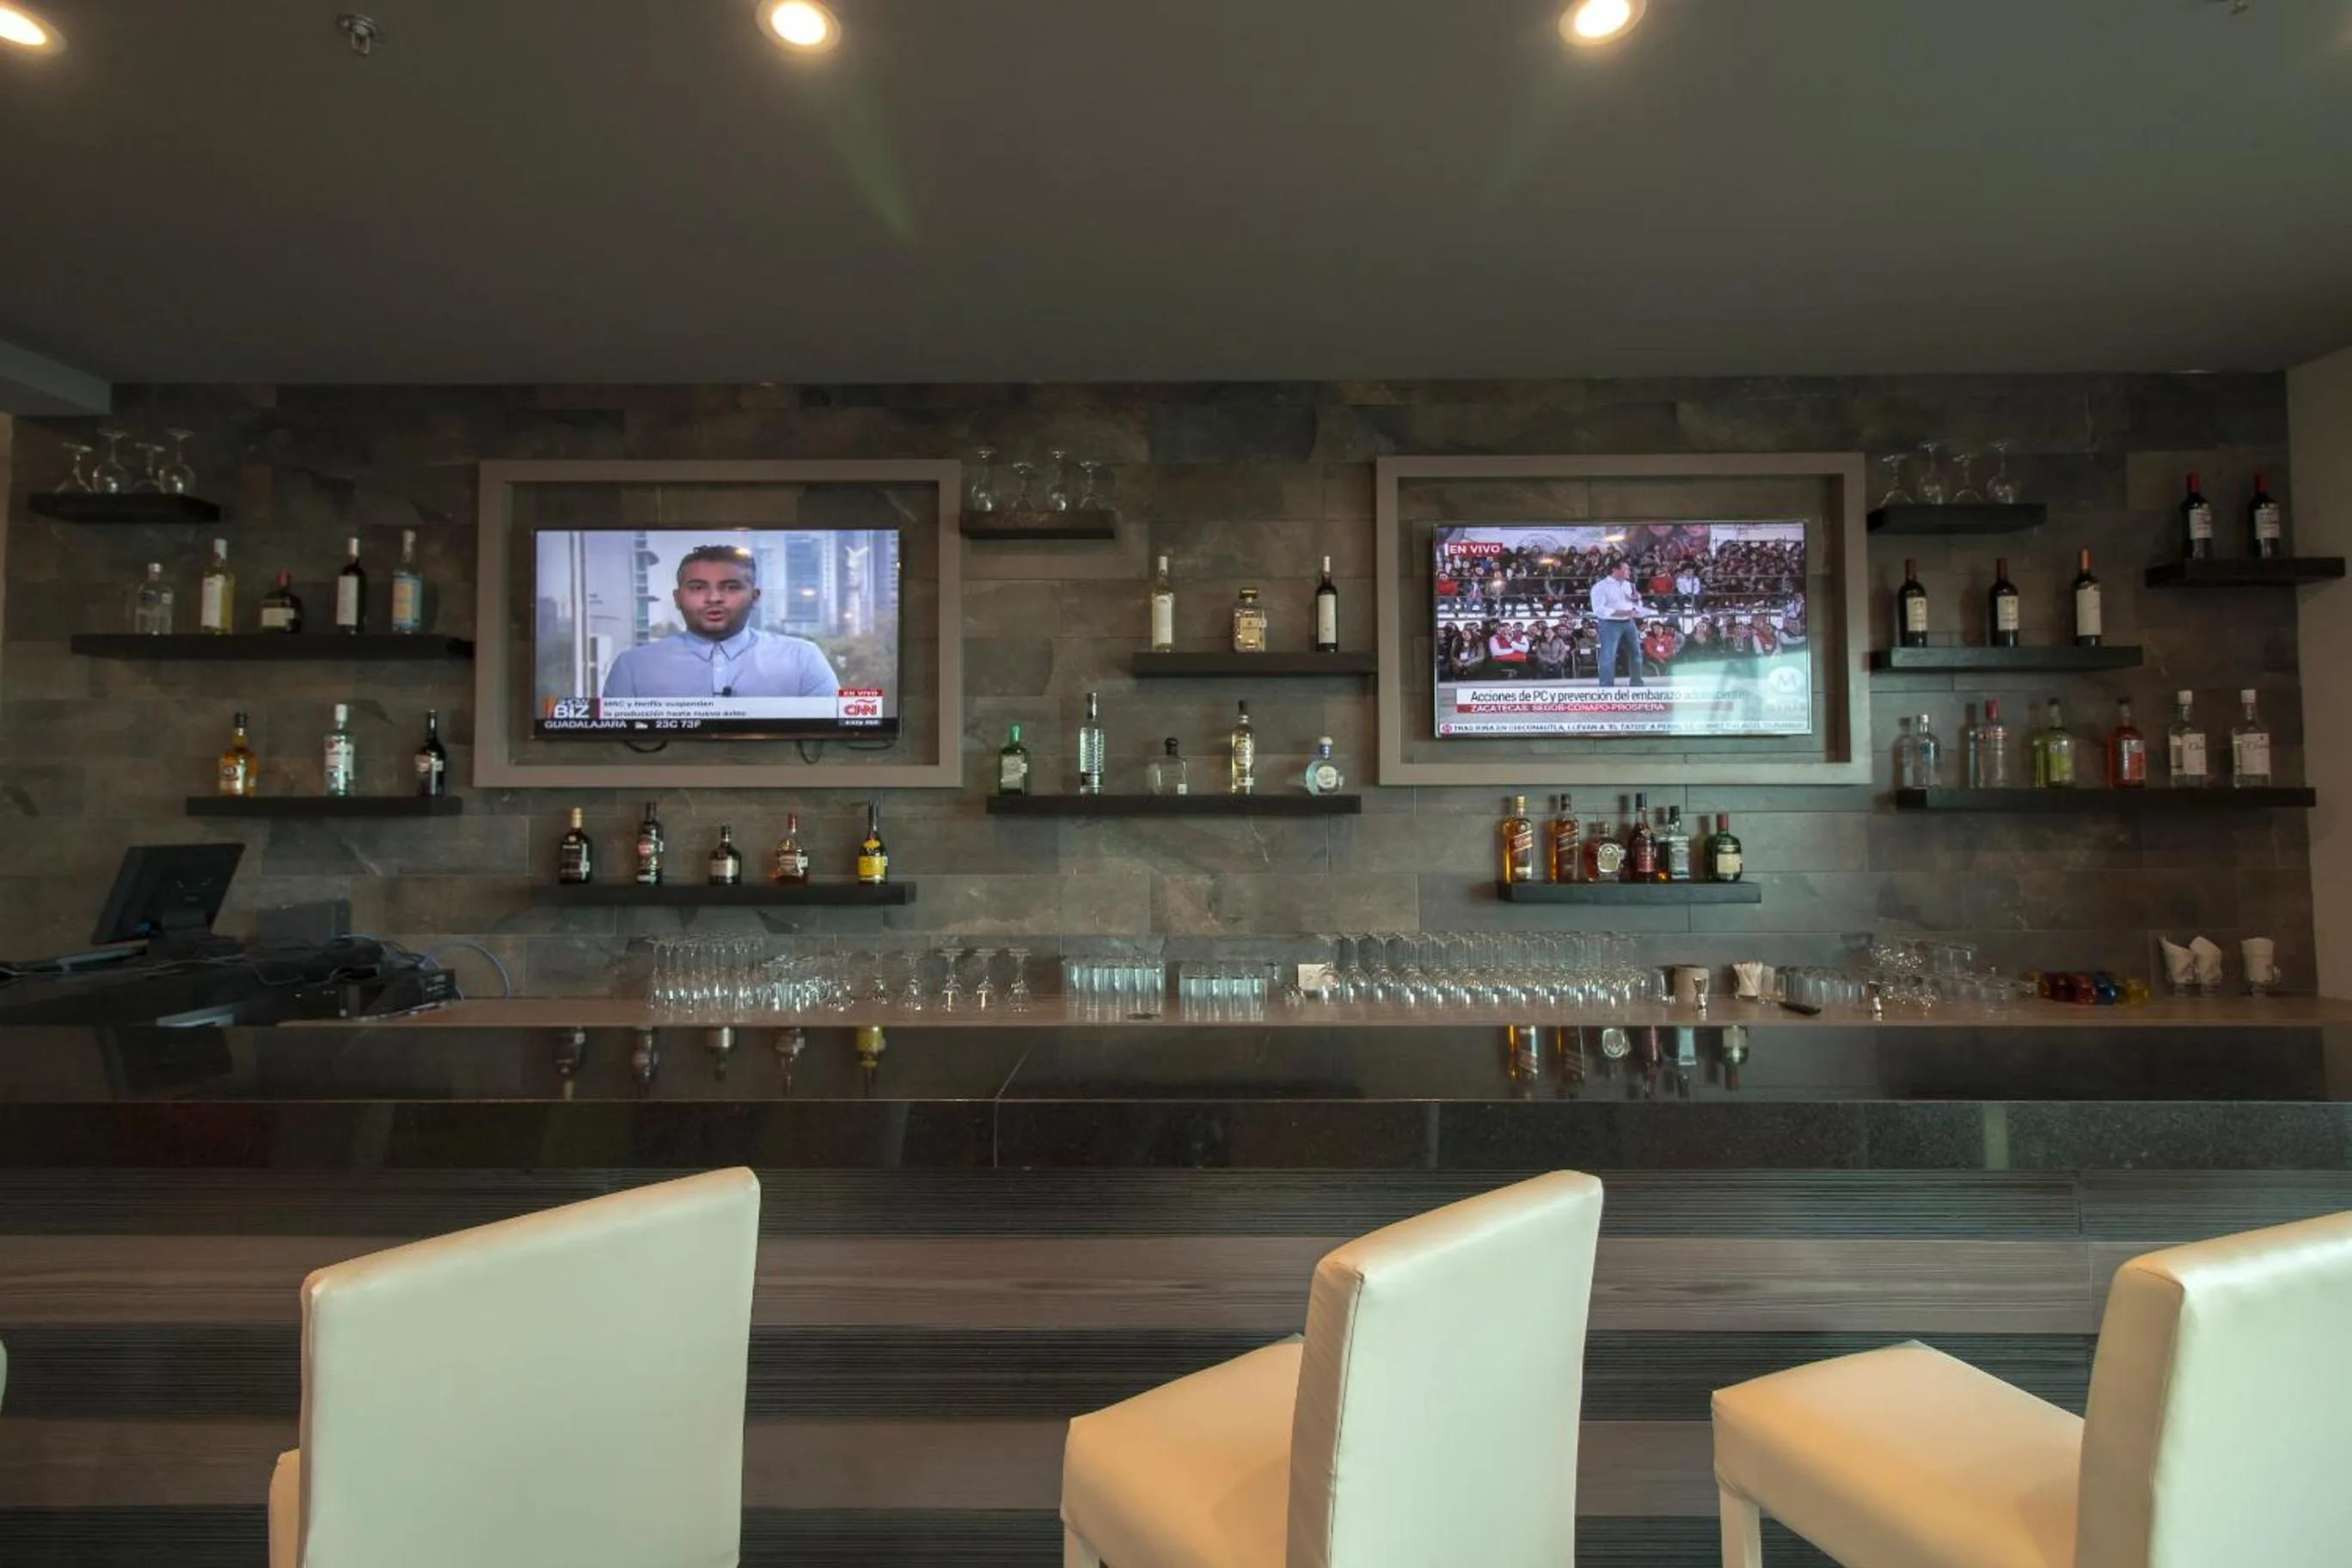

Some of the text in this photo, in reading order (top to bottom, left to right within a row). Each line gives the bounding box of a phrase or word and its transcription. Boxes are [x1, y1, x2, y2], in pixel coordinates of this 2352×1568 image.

[1449, 544, 1500, 554] EN VIVO
[1471, 691, 1517, 701] Acciones
[1519, 690, 1531, 701] de
[1533, 691, 1547, 701] PC
[1549, 693, 1556, 703] y
[1558, 690, 1613, 703] prevención
[1614, 689, 1630, 701] del
[1632, 689, 1681, 701] embarazo
[544, 720, 628, 729] GUADALAJARA
